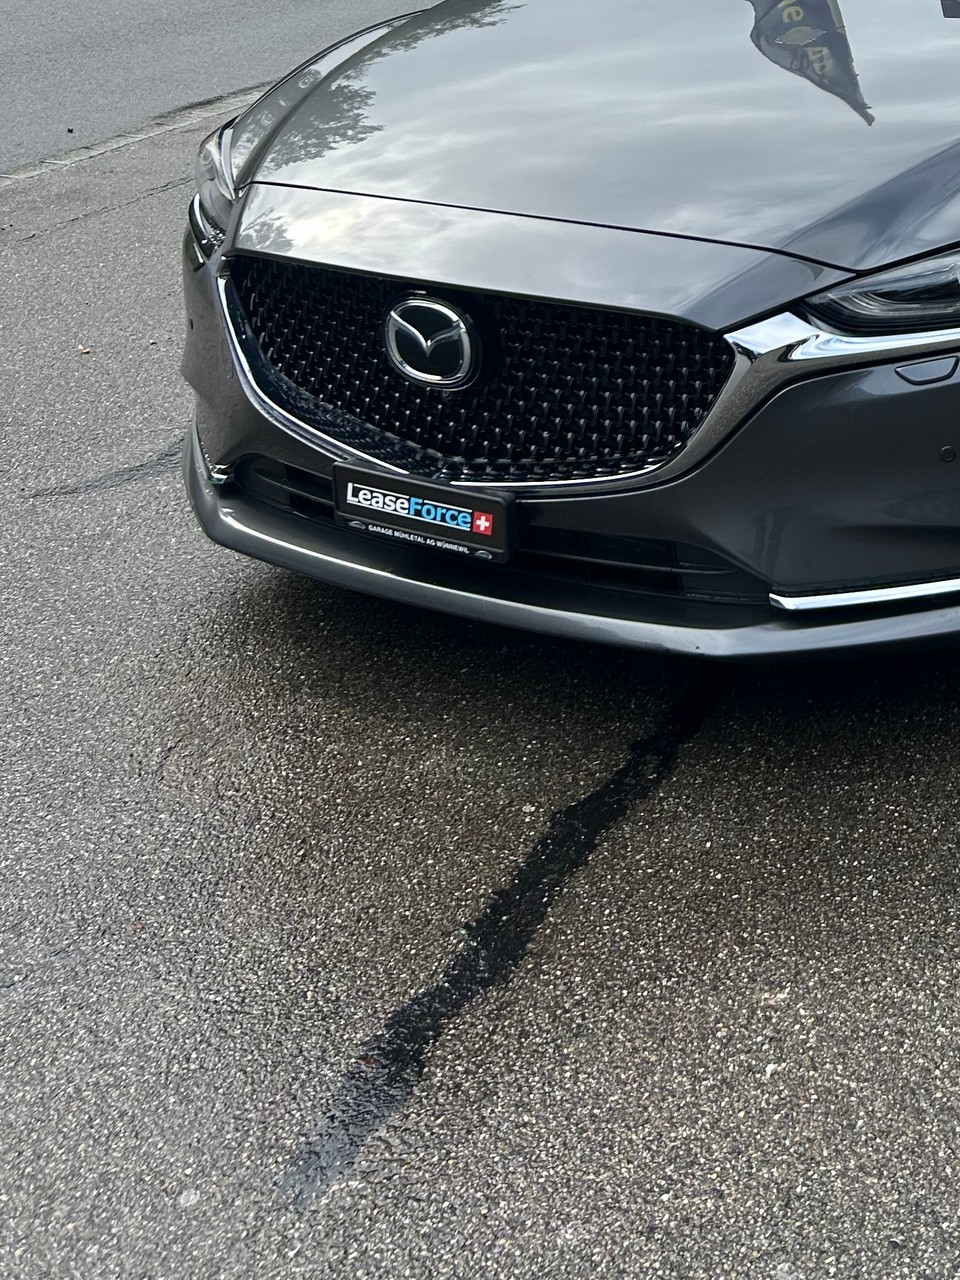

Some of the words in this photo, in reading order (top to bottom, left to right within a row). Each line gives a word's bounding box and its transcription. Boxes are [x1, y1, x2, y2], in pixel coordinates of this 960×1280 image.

[346, 481, 473, 529] LeaseForce
[368, 523, 394, 537] GARAGE
[426, 536, 436, 547] AG
